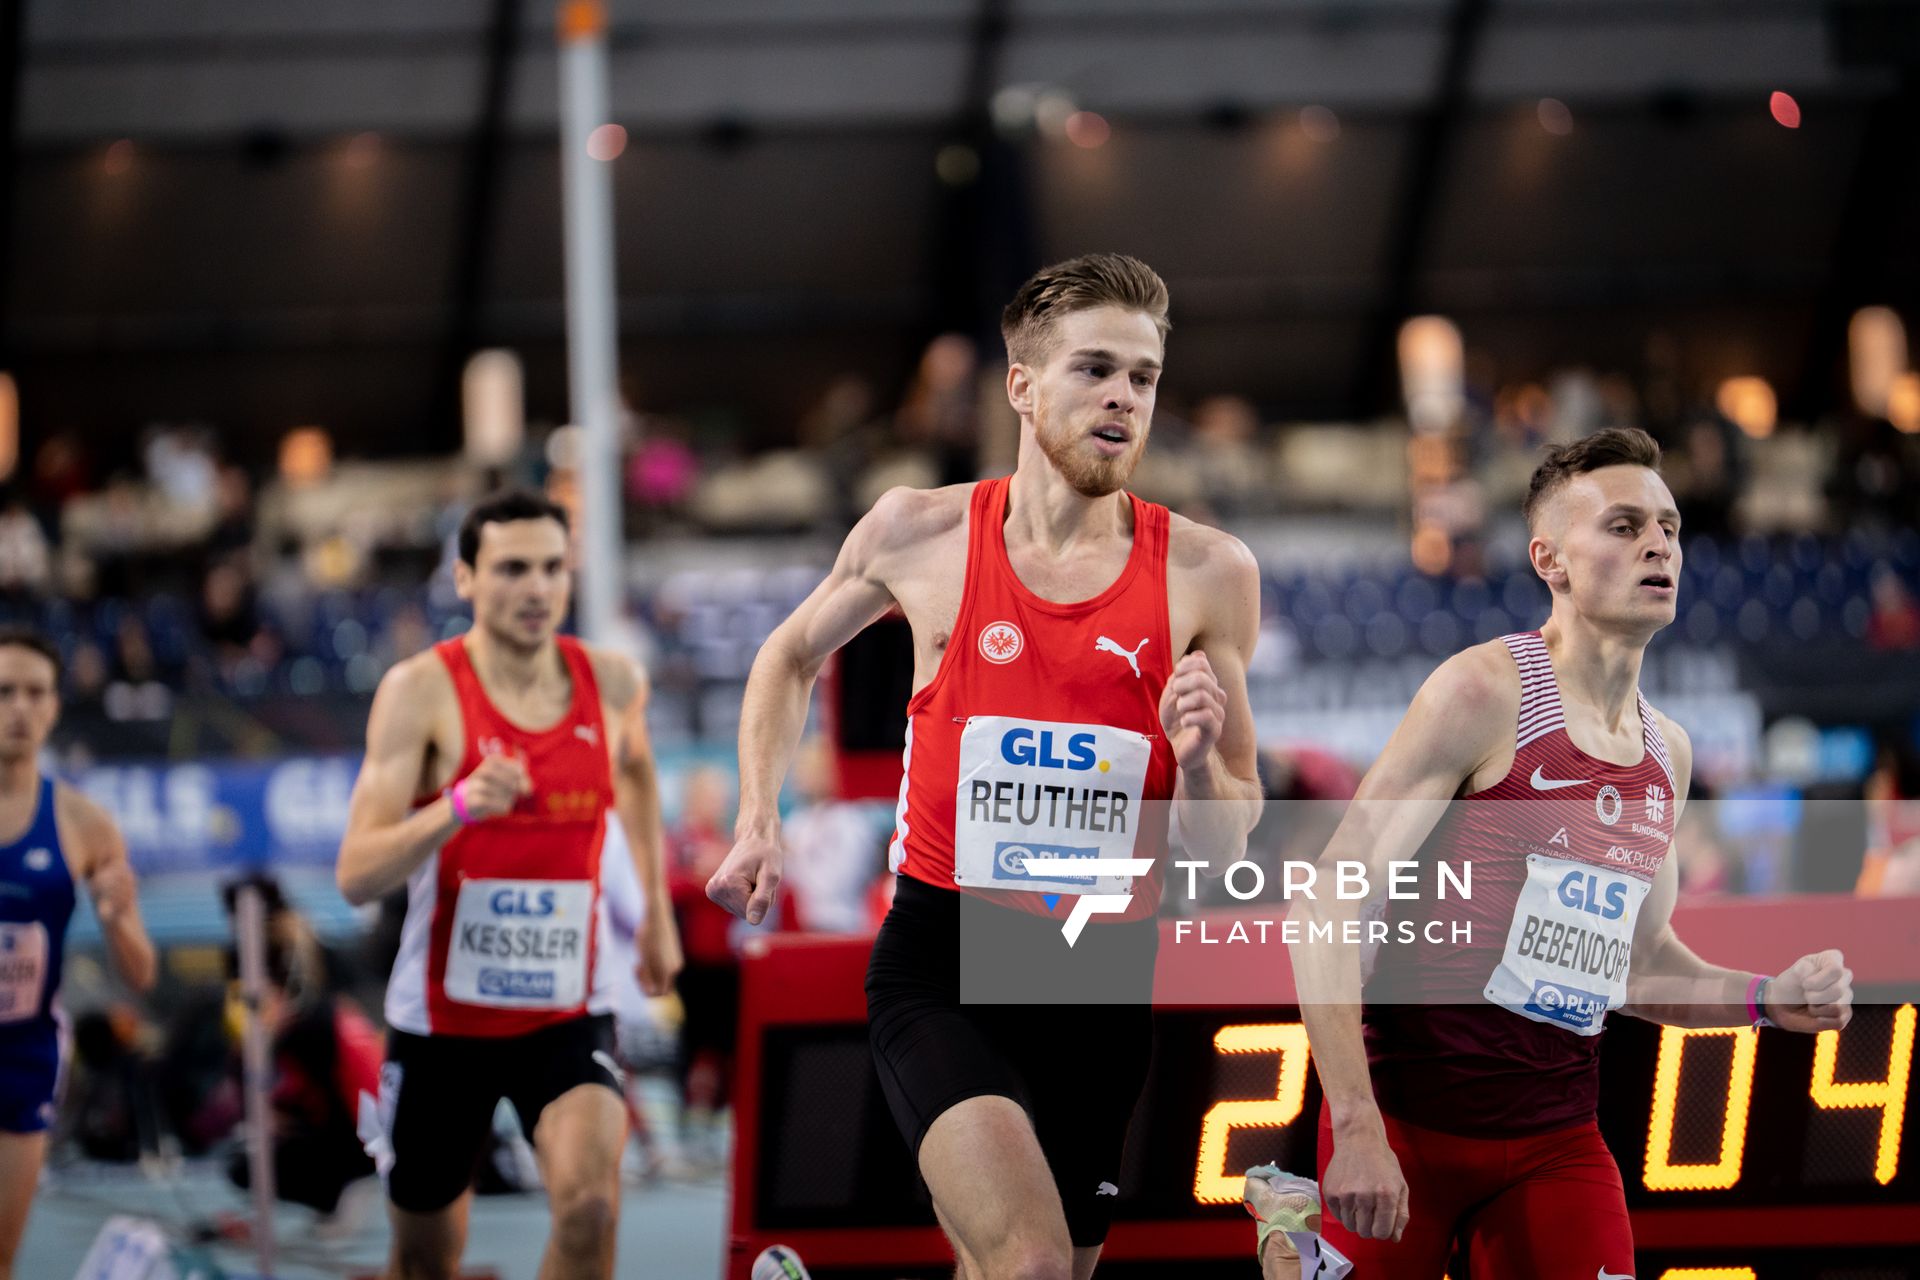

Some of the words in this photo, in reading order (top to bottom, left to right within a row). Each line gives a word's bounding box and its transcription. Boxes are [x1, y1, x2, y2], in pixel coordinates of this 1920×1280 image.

[969, 780, 1129, 834] REUTHER
[458, 921, 579, 960] KESSLER
[1193, 1021, 1312, 1206] 2
[1642, 1003, 1918, 1192] 04
